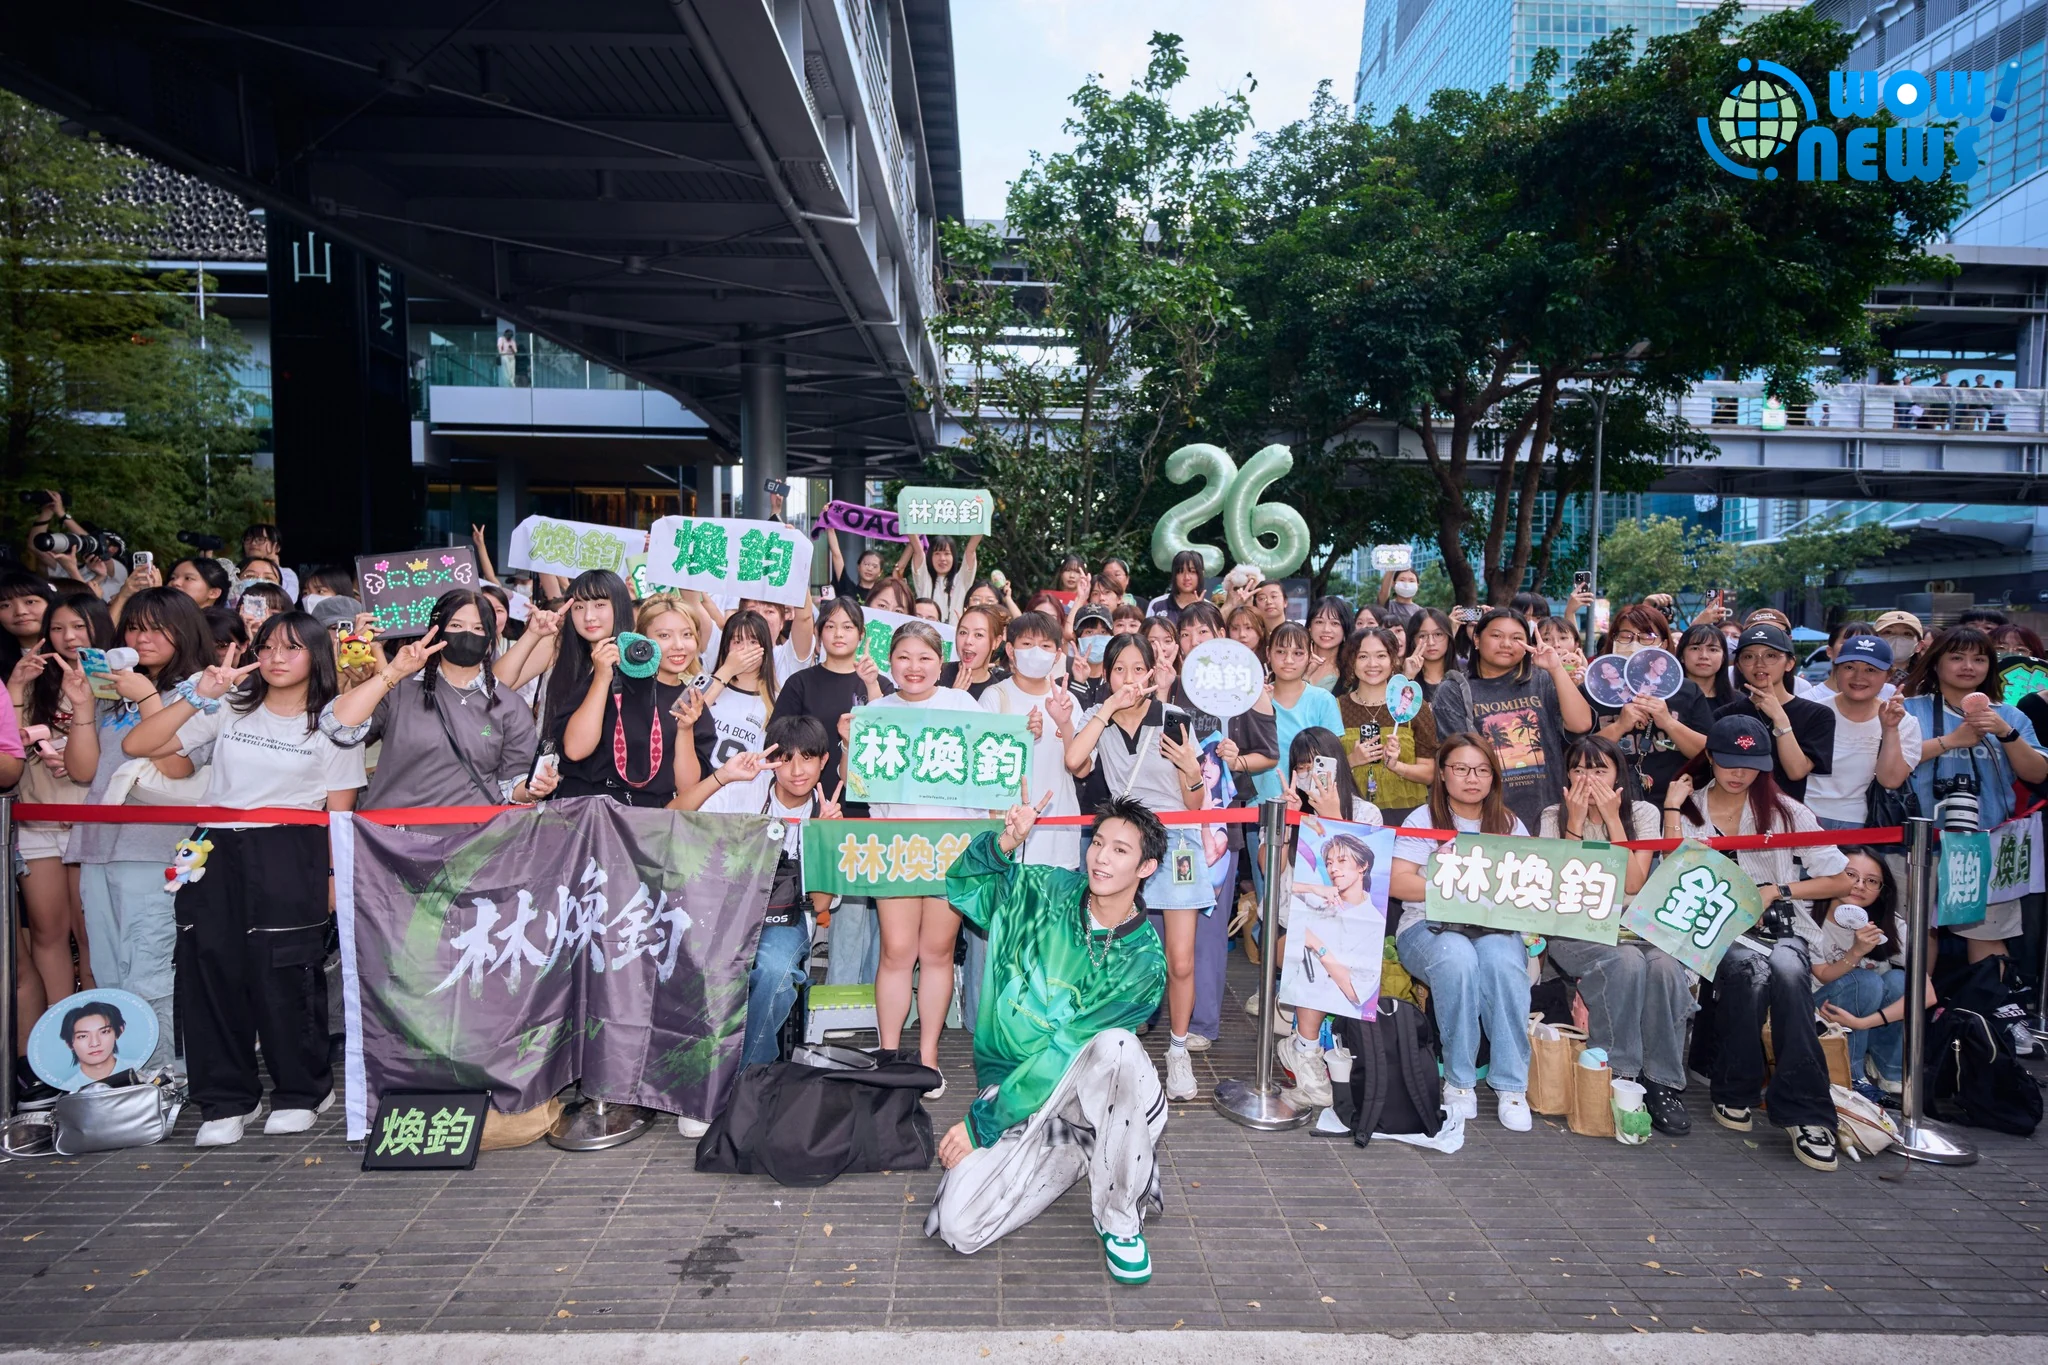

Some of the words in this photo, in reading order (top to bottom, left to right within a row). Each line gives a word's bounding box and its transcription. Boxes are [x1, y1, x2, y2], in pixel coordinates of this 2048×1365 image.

[293, 231, 331, 283] 山
[378, 262, 393, 336] HAN
[908, 498, 983, 524] 林煥鈞
[1152, 442, 1310, 579] 26
[529, 520, 626, 573] 煥鈞
[671, 519, 794, 587] 煥鈞
[386, 568, 454, 590] Rex
[1194, 663, 1252, 693] 煥鈞
[261, 743, 312, 756] DISAPPOINTED
[852, 724, 1028, 790] 林煥鈞
[1433, 844, 1618, 921] 林煥鈞
[1655, 865, 1738, 949] 鈞
[424, 857, 693, 1000] 林煥鈞
[765, 914, 788, 923] EOS
[375, 1107, 476, 1156] 煥鈞
